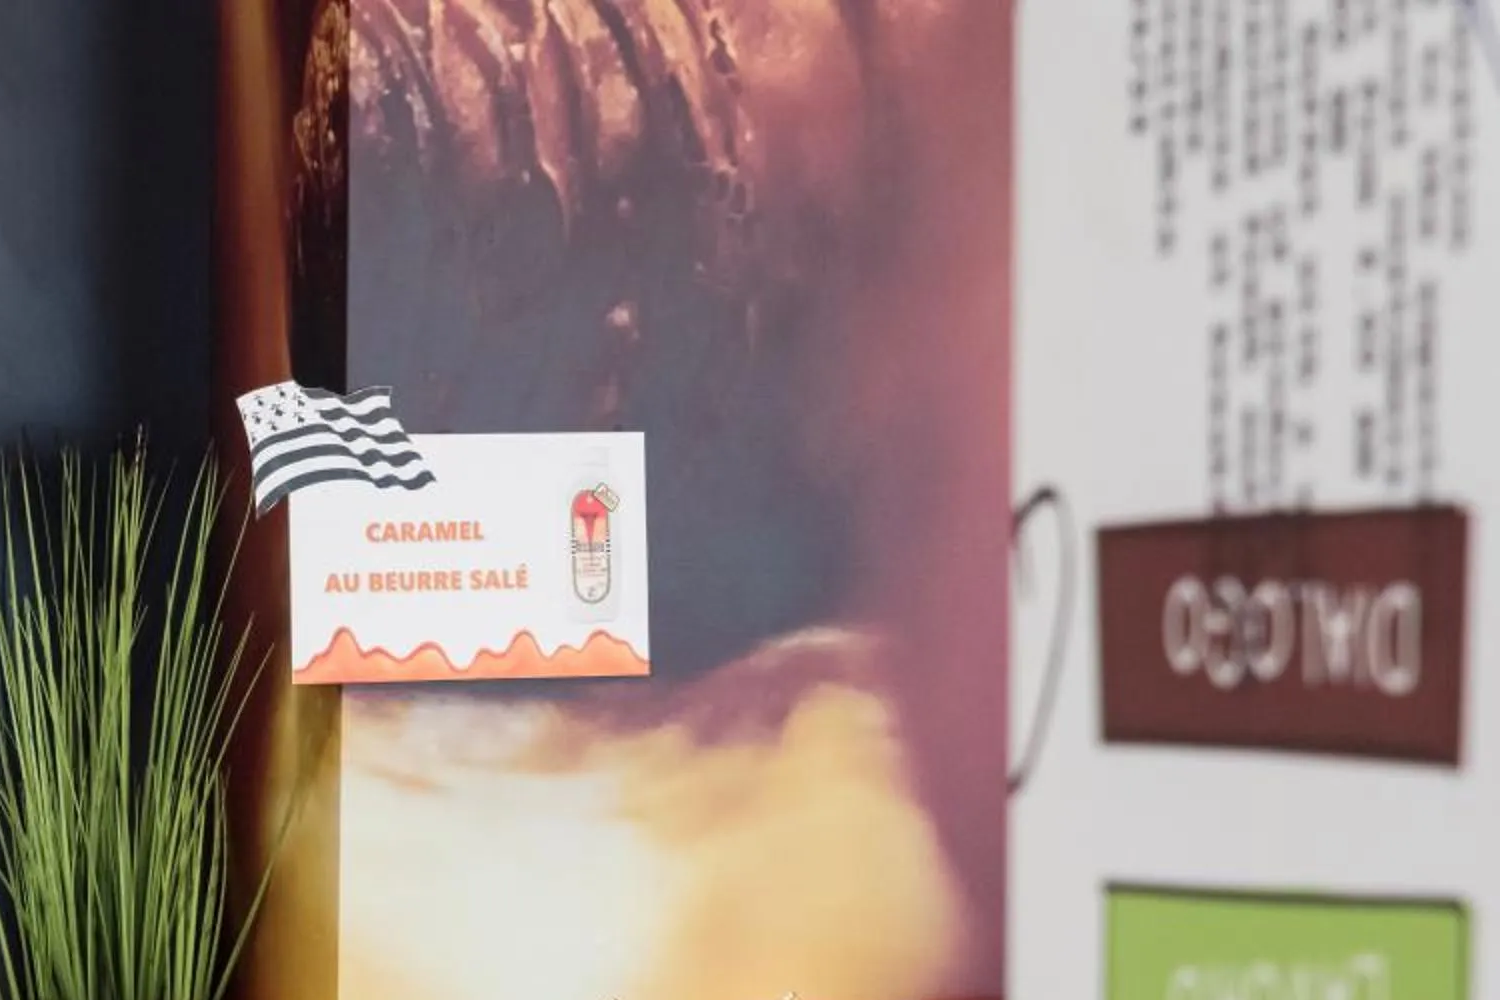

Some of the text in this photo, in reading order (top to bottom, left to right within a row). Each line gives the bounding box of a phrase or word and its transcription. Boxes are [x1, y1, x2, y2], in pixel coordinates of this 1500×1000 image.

[364, 520, 485, 543] CARAMEL
[324, 563, 530, 593] AU BEURRE SALÉ
